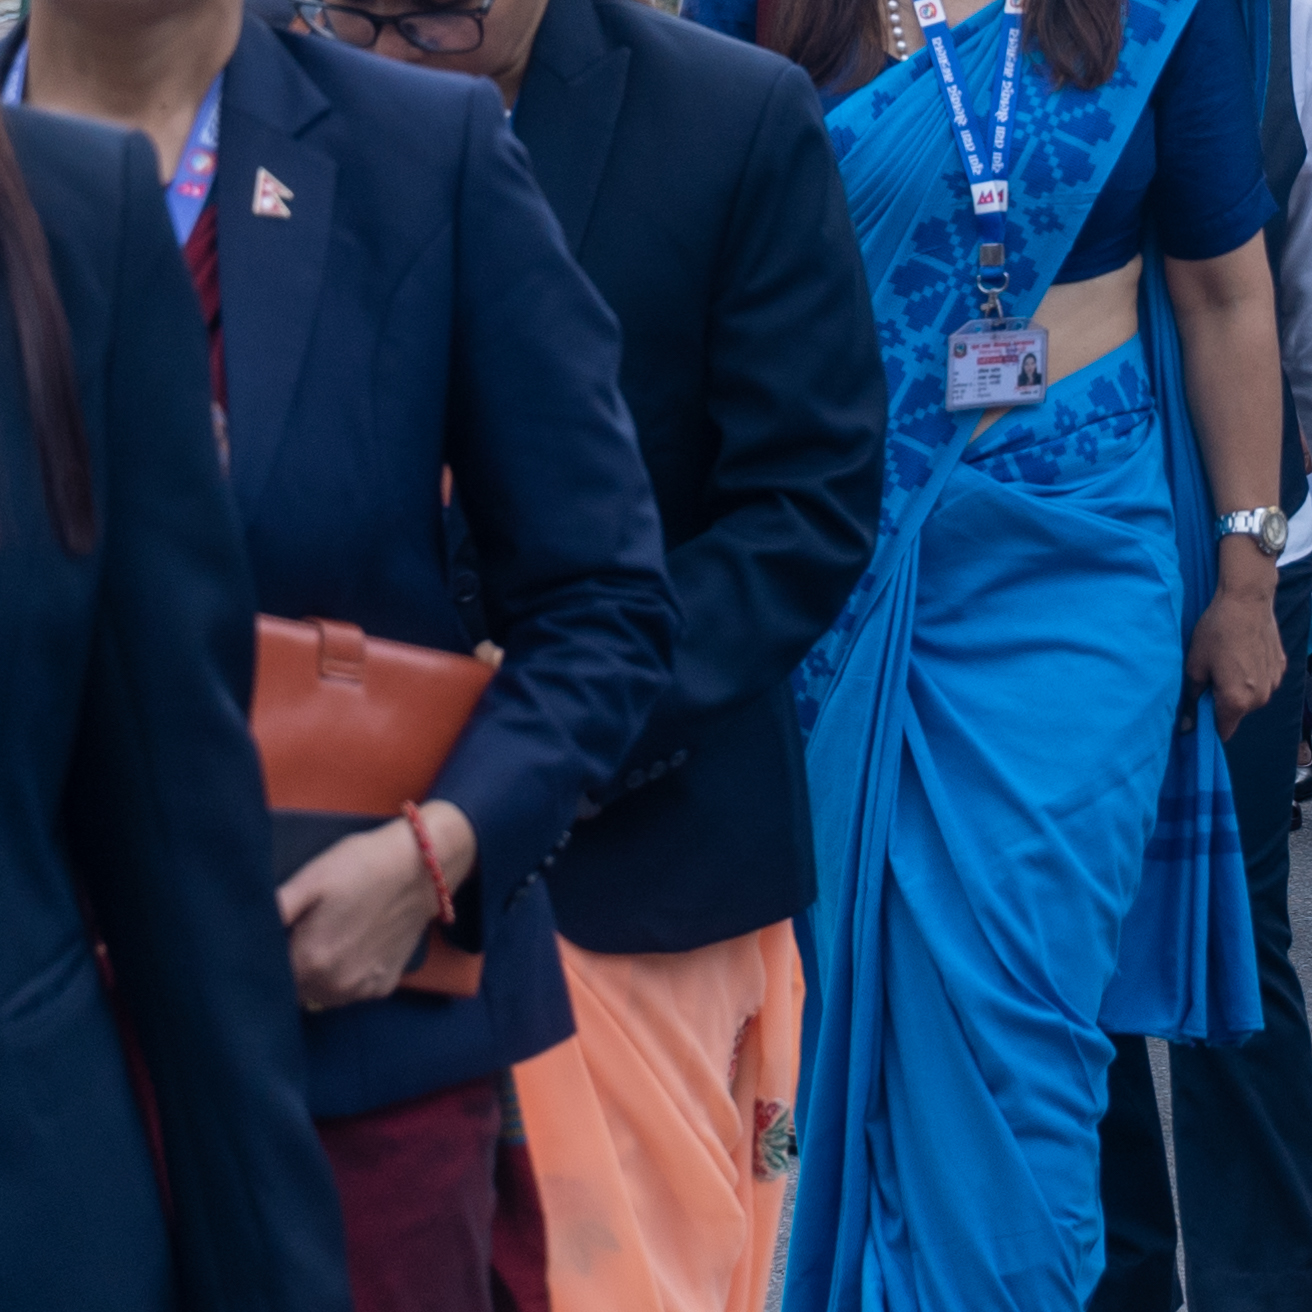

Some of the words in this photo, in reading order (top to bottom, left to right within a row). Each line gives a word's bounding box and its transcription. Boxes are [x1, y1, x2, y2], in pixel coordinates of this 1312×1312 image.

[960, 129, 976, 153] तथा
[994, 125, 1006, 149] तथा
[968, 154, 984, 176] युवा
[991, 151, 1004, 174] युवा
